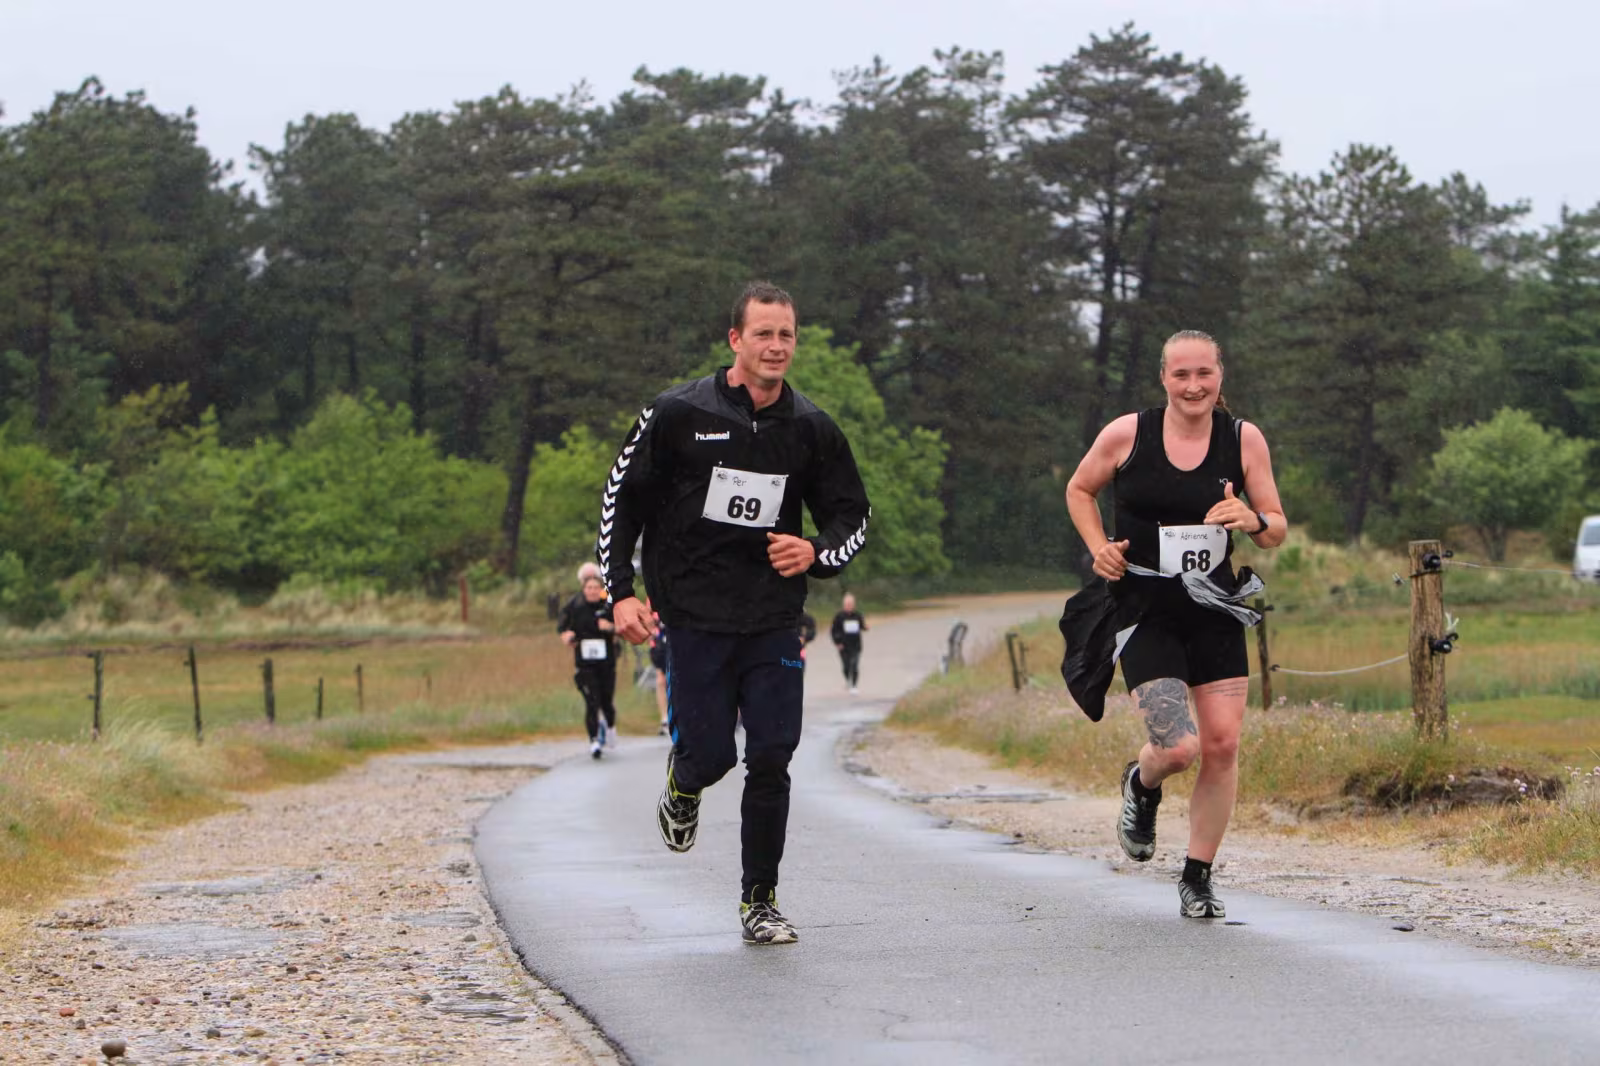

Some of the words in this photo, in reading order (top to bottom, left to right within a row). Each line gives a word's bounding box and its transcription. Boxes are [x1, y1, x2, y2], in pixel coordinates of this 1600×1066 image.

[695, 431, 730, 440] hummel
[727, 495, 761, 522] 69
[1182, 549, 1211, 573] 68
